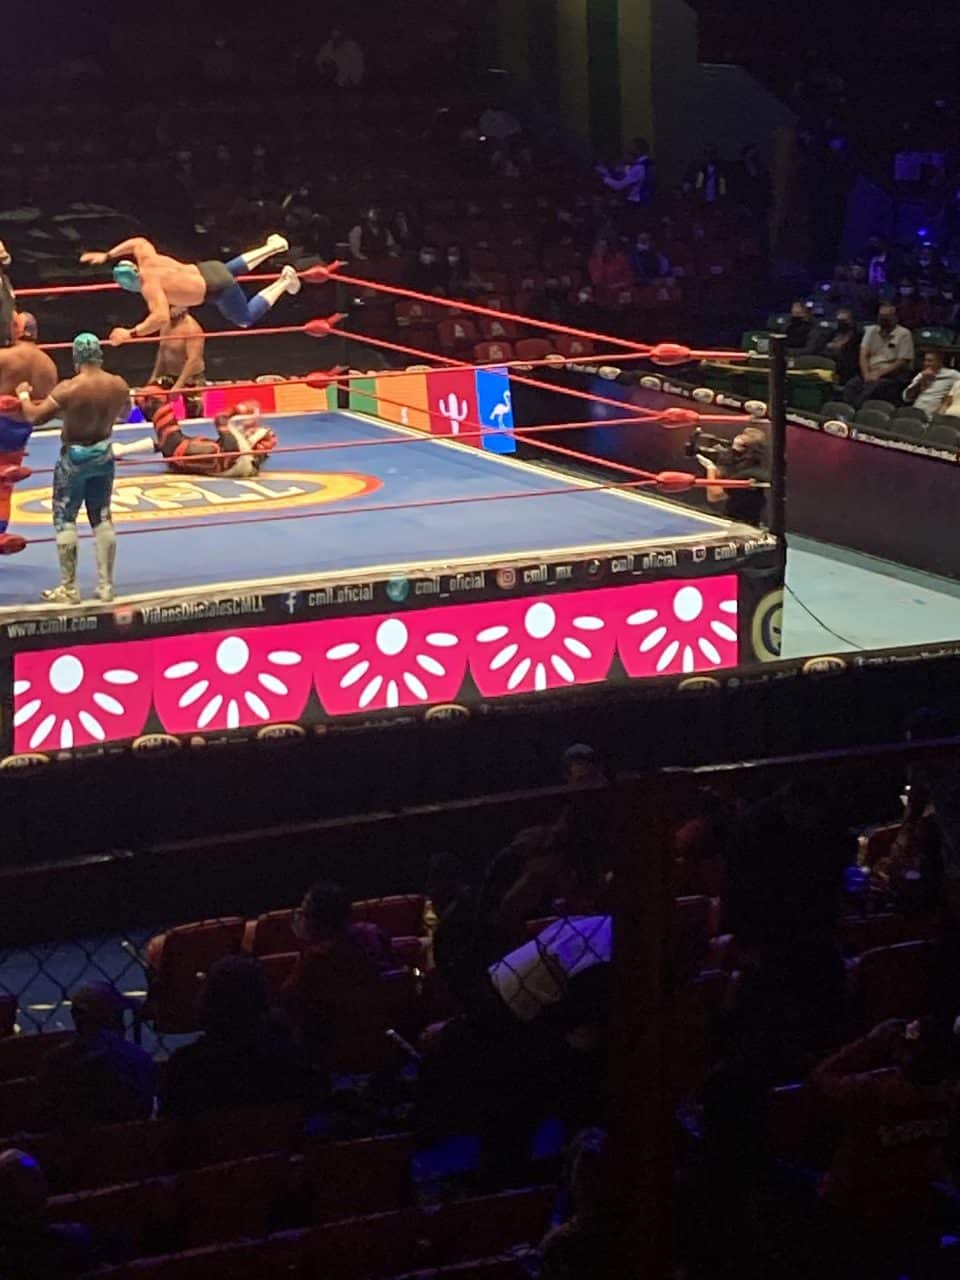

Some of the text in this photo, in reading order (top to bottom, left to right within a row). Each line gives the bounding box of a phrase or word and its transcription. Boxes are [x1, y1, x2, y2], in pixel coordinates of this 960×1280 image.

[523, 564, 573, 585] cmll_mx
[611, 550, 678, 575] cmll_oficial
[415, 572, 486, 598] cmll_oficial
[7, 615, 98, 639] www.cmll.com
